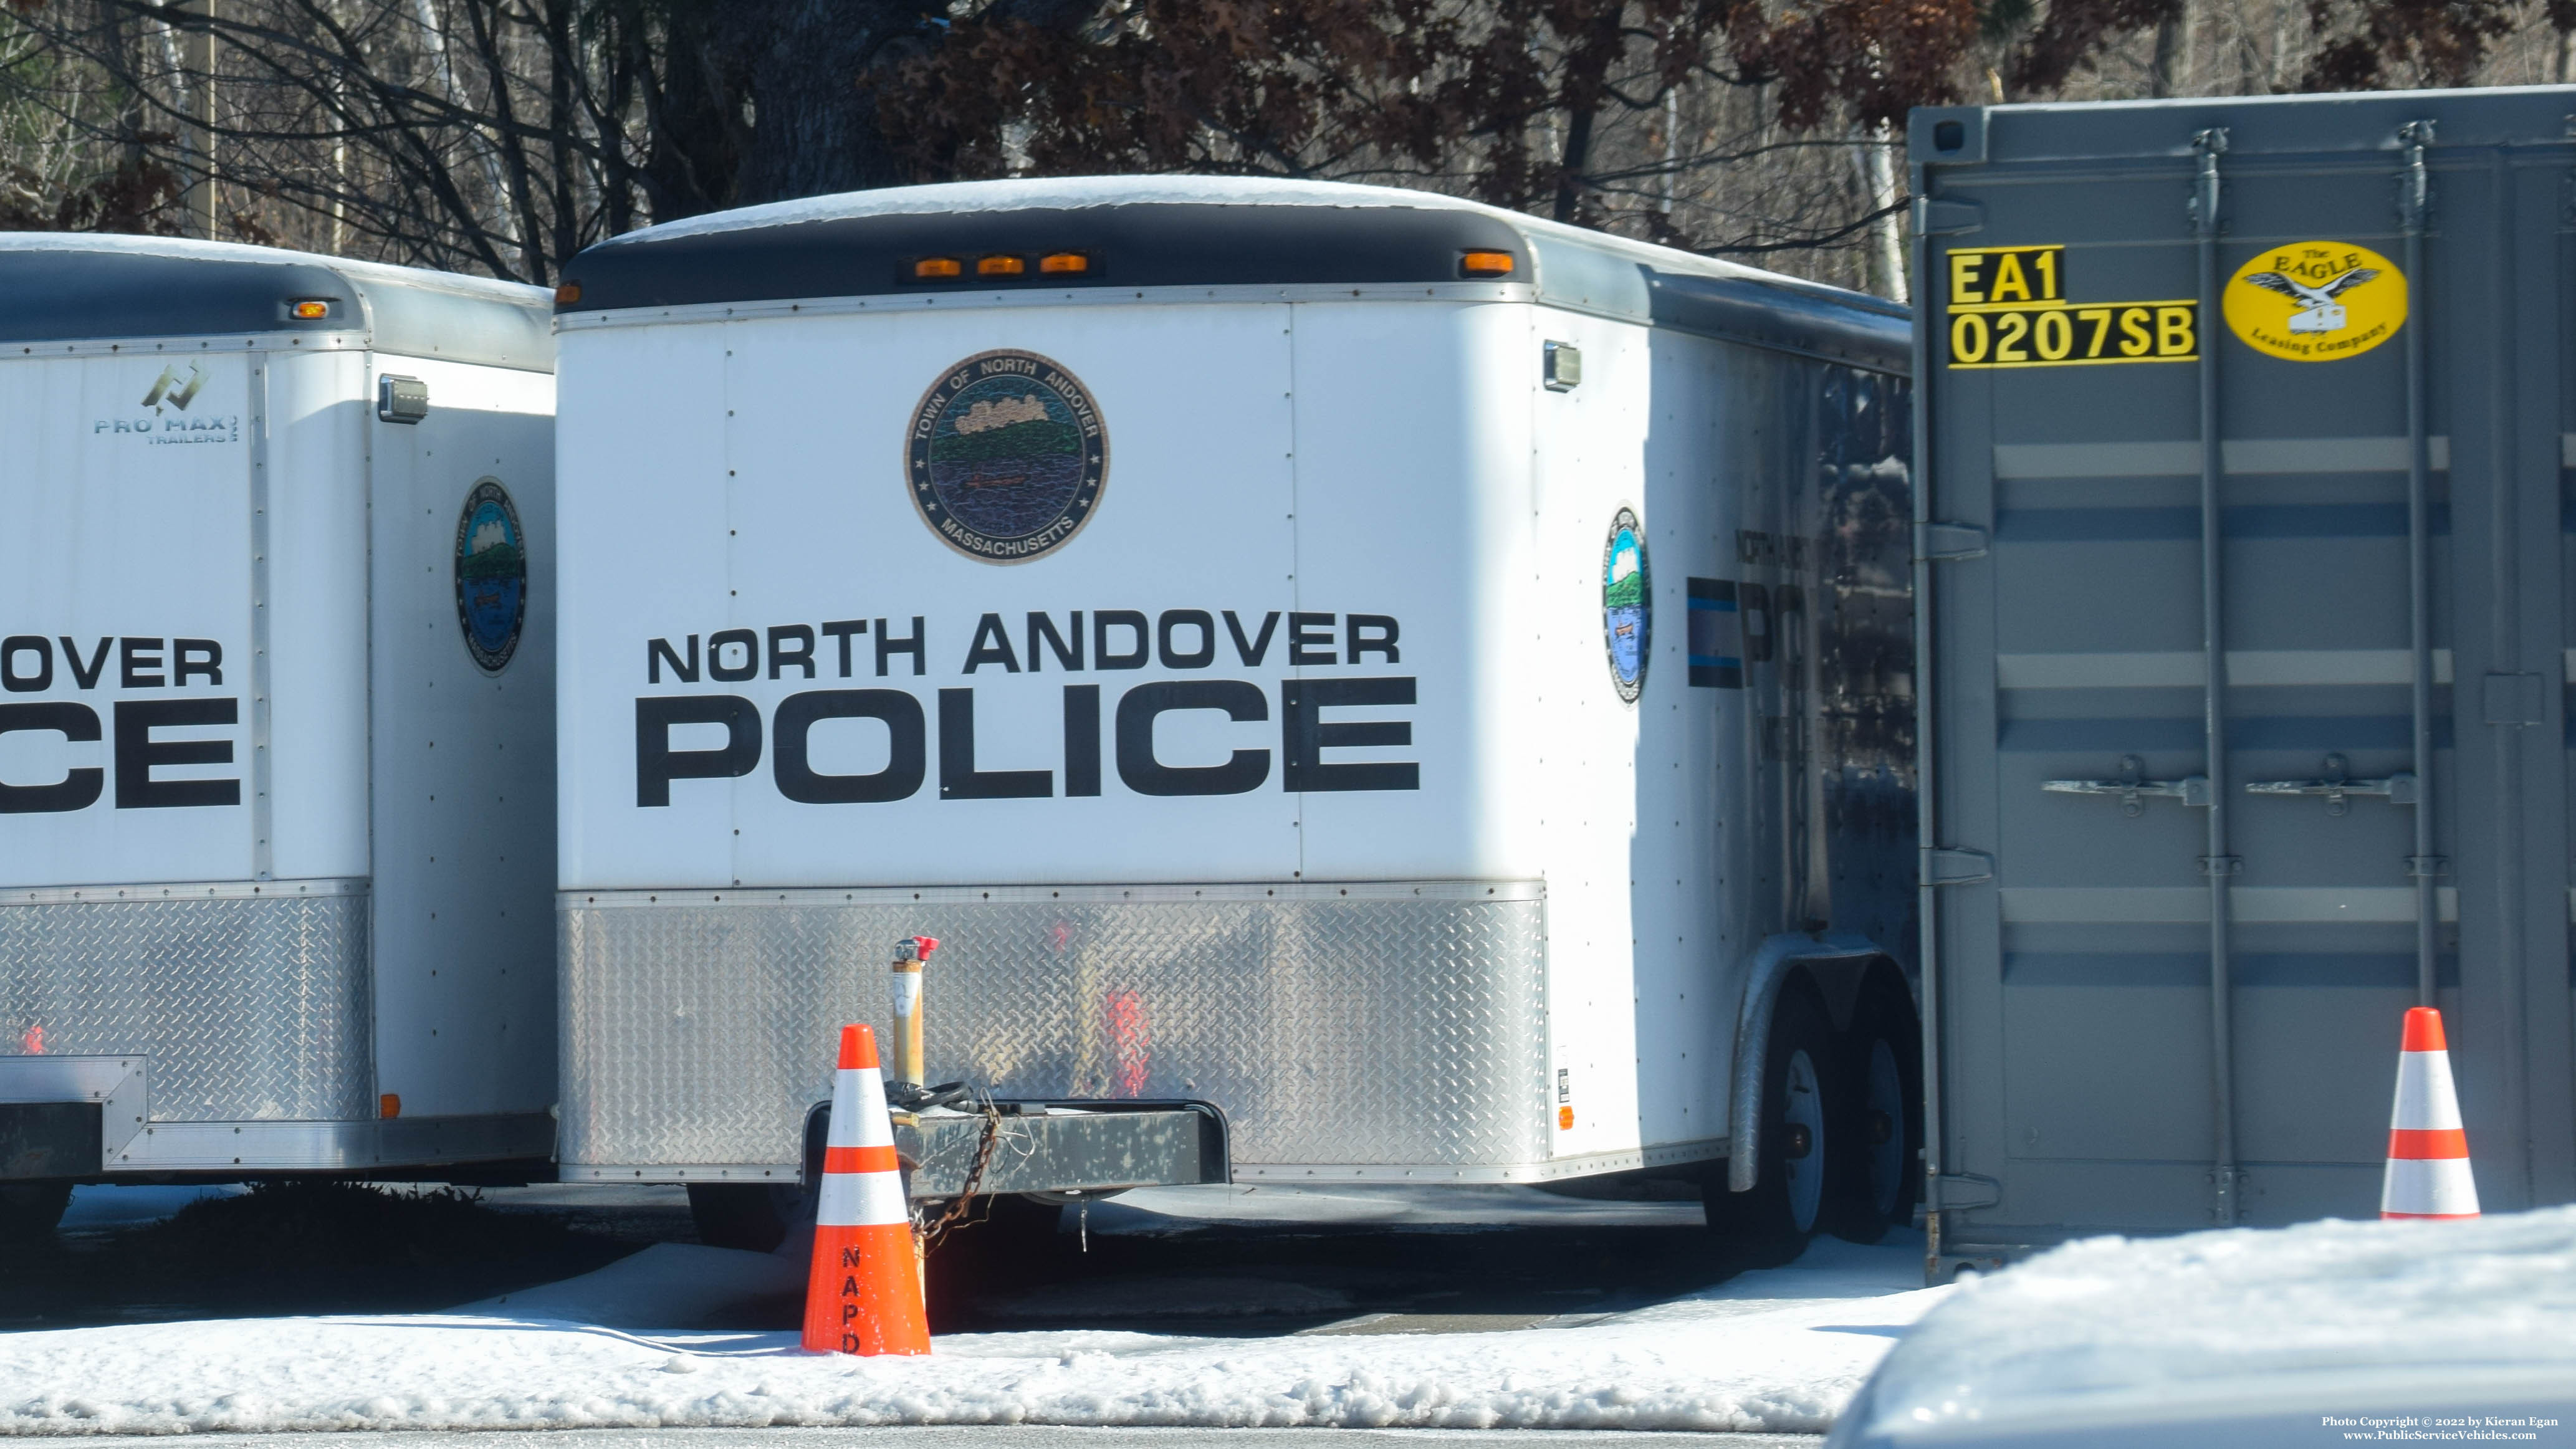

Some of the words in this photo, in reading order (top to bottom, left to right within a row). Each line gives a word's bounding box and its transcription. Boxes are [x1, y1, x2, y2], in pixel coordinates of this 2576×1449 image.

[2274, 252, 2362, 279] EAGLE
[2303, 249, 2330, 259] The
[1951, 250, 2057, 304] EA1
[1951, 307, 2196, 363] 0207SB
[2251, 327, 2310, 355] Leasing
[2316, 322, 2388, 353] Company
[915, 393, 947, 439] TOWN
[950, 370, 969, 390] OF
[980, 358, 1037, 375] NORTH
[1045, 371, 1098, 438] ANDOVER
[94, 419, 152, 434] PRO
[164, 414, 226, 431] MAX
[147, 435, 226, 444] TRAILERS
[941, 516, 1075, 555] MASSACHUSETTS
[647, 616, 925, 684] NORTH
[962, 609, 1401, 674] ANDOVER
[635, 676, 1420, 808] POLICE
